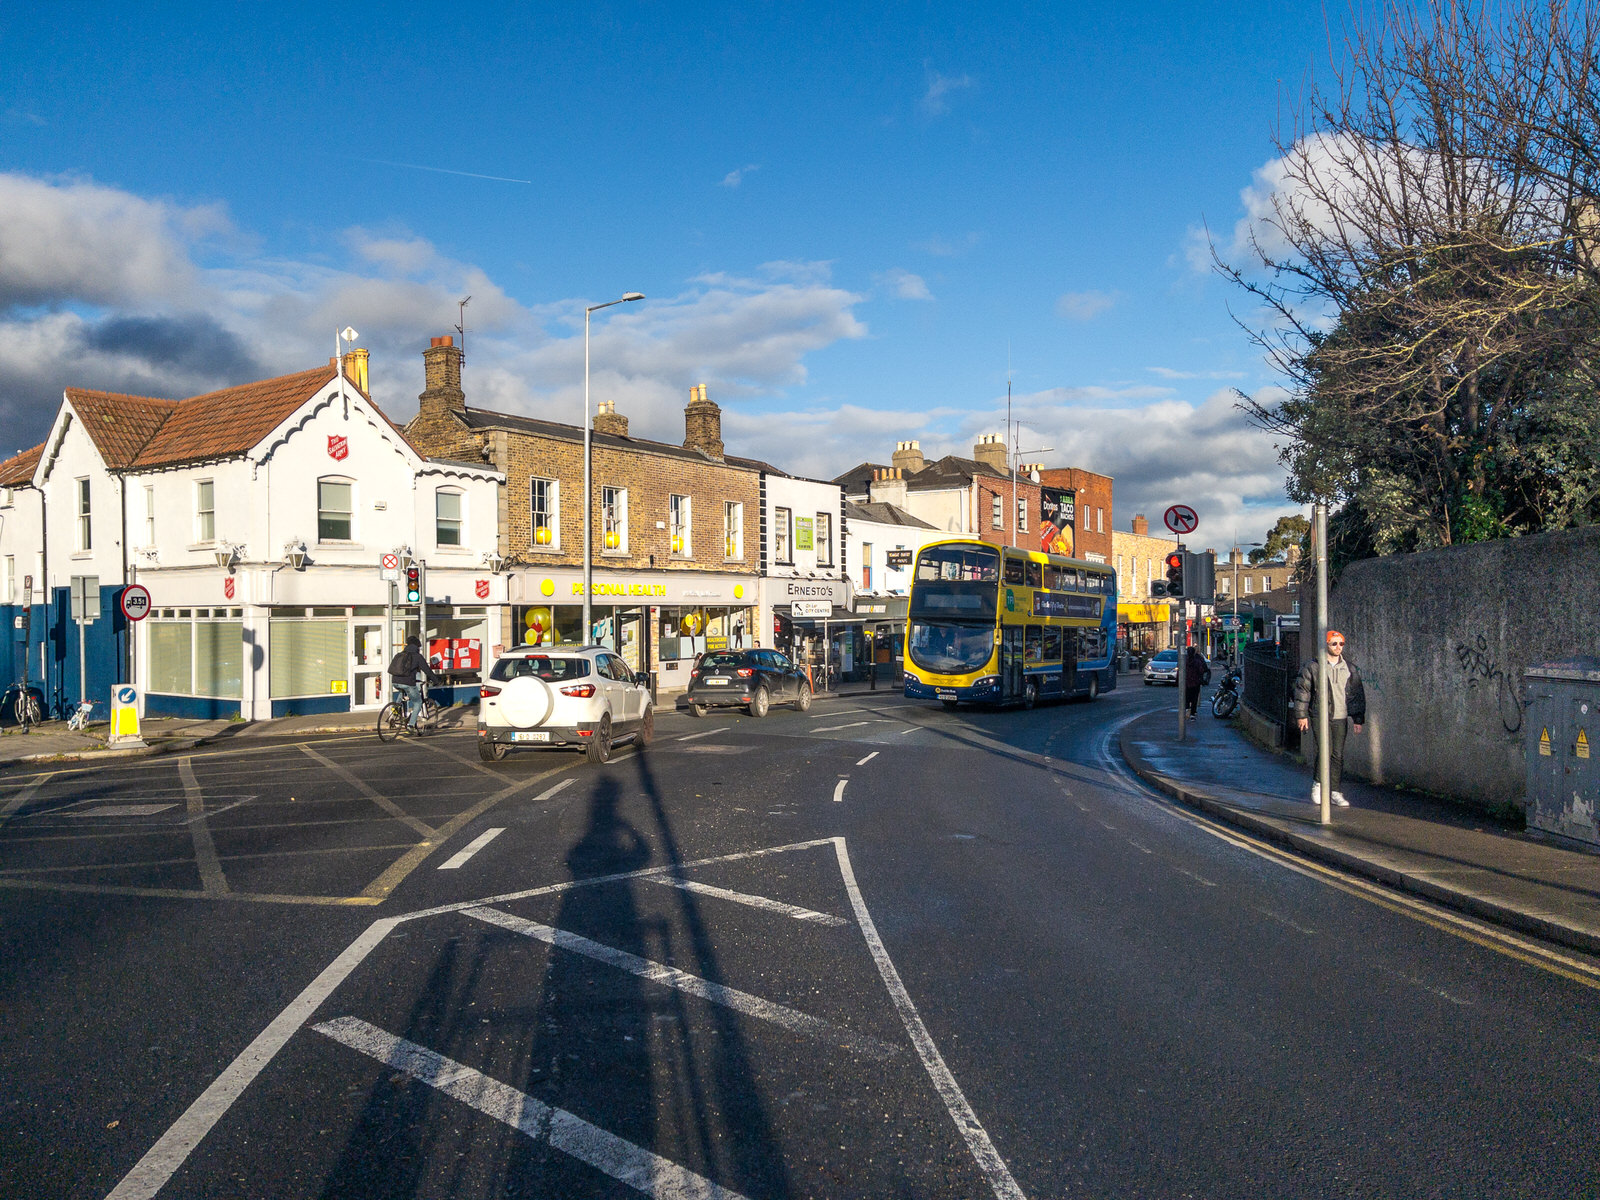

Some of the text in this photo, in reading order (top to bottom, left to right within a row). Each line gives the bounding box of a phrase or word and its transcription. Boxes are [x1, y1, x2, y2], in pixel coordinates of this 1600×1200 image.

[330, 437, 340, 446] THE
[1043, 501, 1059, 511] Doritos
[1060, 503, 1073, 514] TACO
[571, 582, 627, 596] PESONAL
[628, 584, 667, 597] HEALTH
